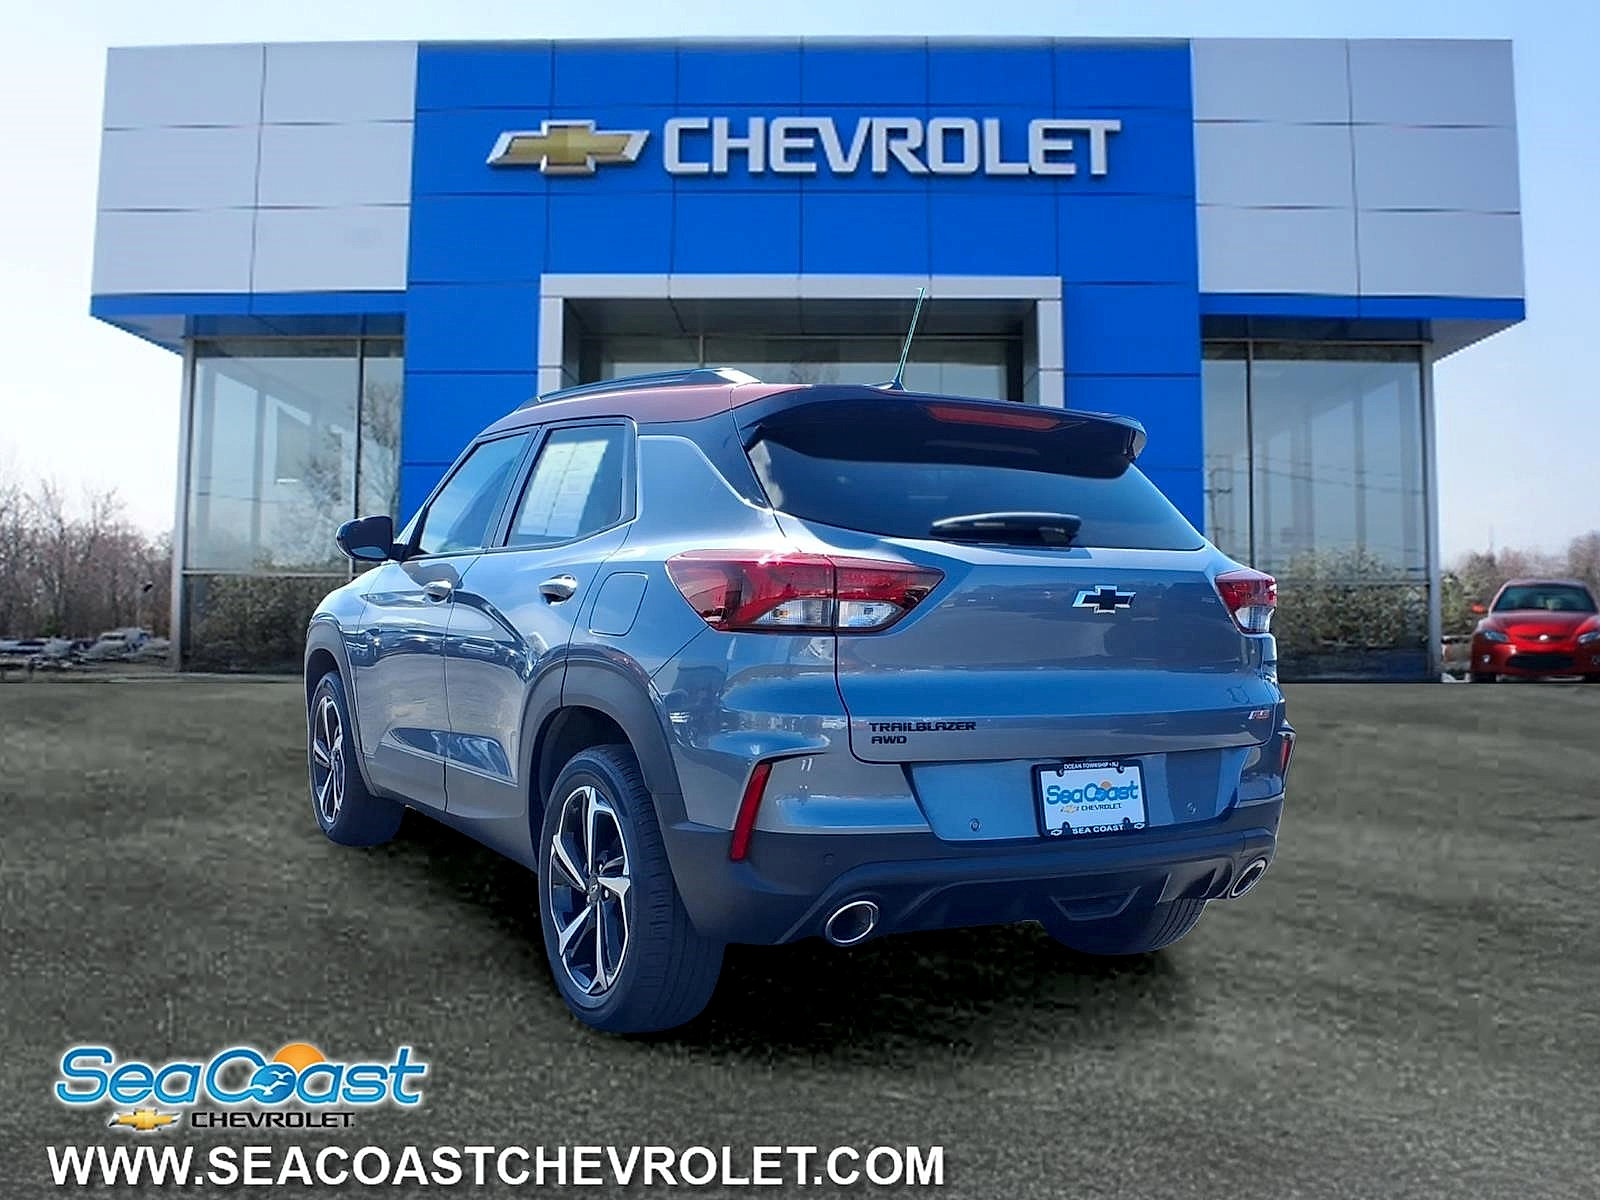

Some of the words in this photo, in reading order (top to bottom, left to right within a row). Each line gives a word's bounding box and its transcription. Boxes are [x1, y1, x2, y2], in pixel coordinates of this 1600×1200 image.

[663, 116, 1122, 176] CHEVROLET
[869, 722, 976, 732] TRAILBLAZER
[871, 735, 907, 744] AWD
[1081, 803, 1122, 812] CHEVROLET
[1071, 826, 1091, 835] SEA
[1093, 824, 1124, 833] COAST
